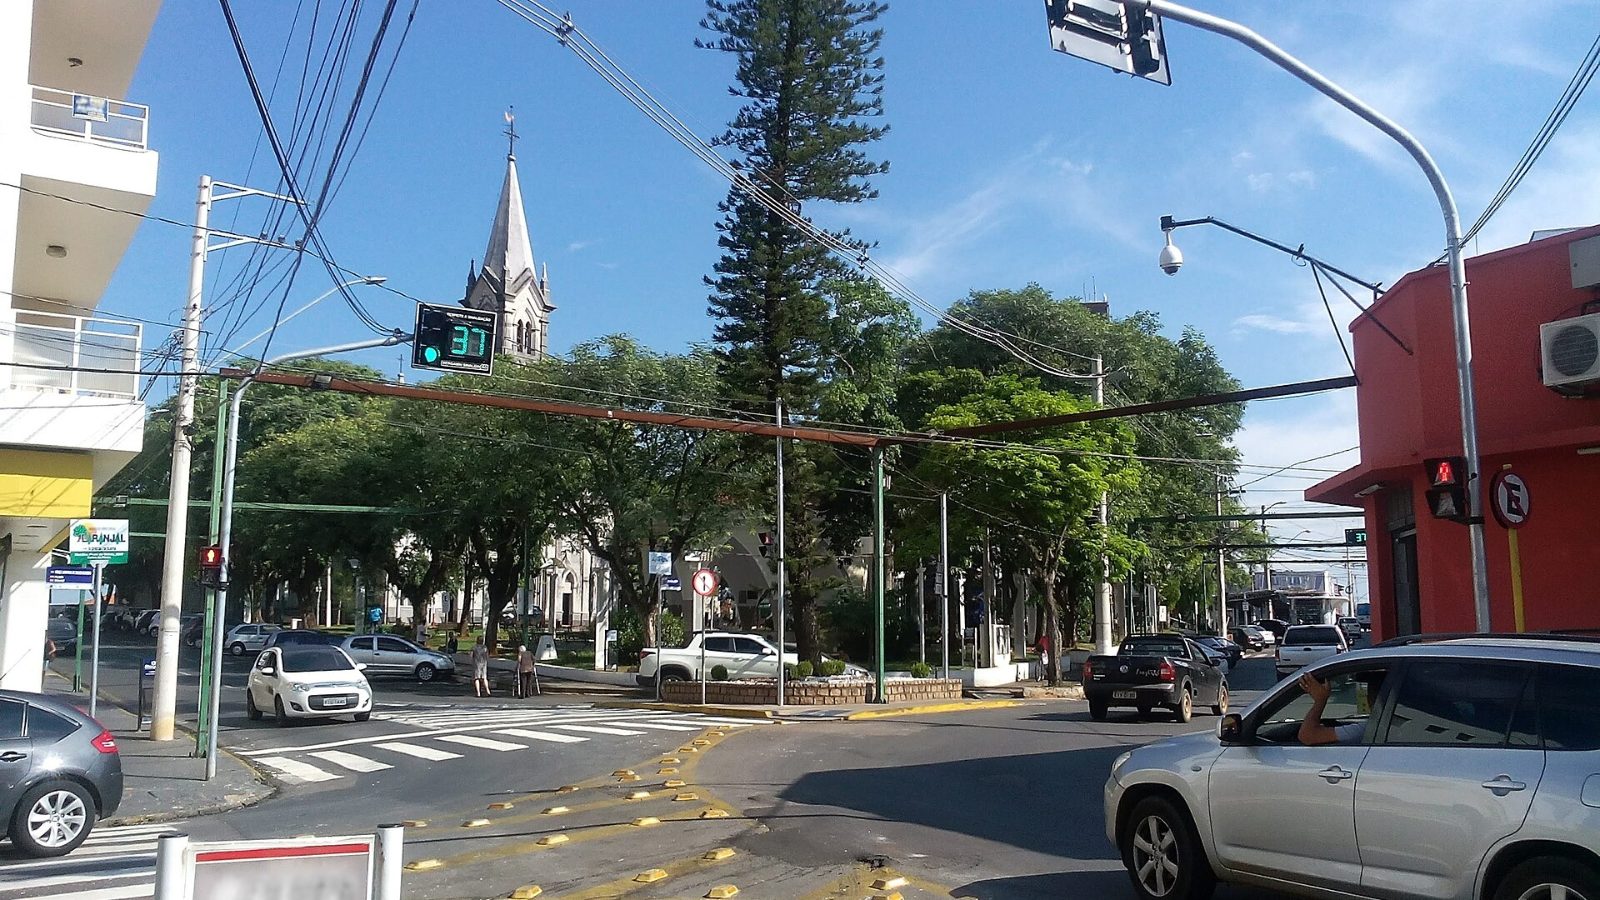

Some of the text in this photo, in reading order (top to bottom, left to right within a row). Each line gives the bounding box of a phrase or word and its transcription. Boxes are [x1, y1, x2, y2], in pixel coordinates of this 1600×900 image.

[451, 326, 486, 356] 37
[1506, 483, 1522, 516] E
[1355, 532, 1367, 543] 37
